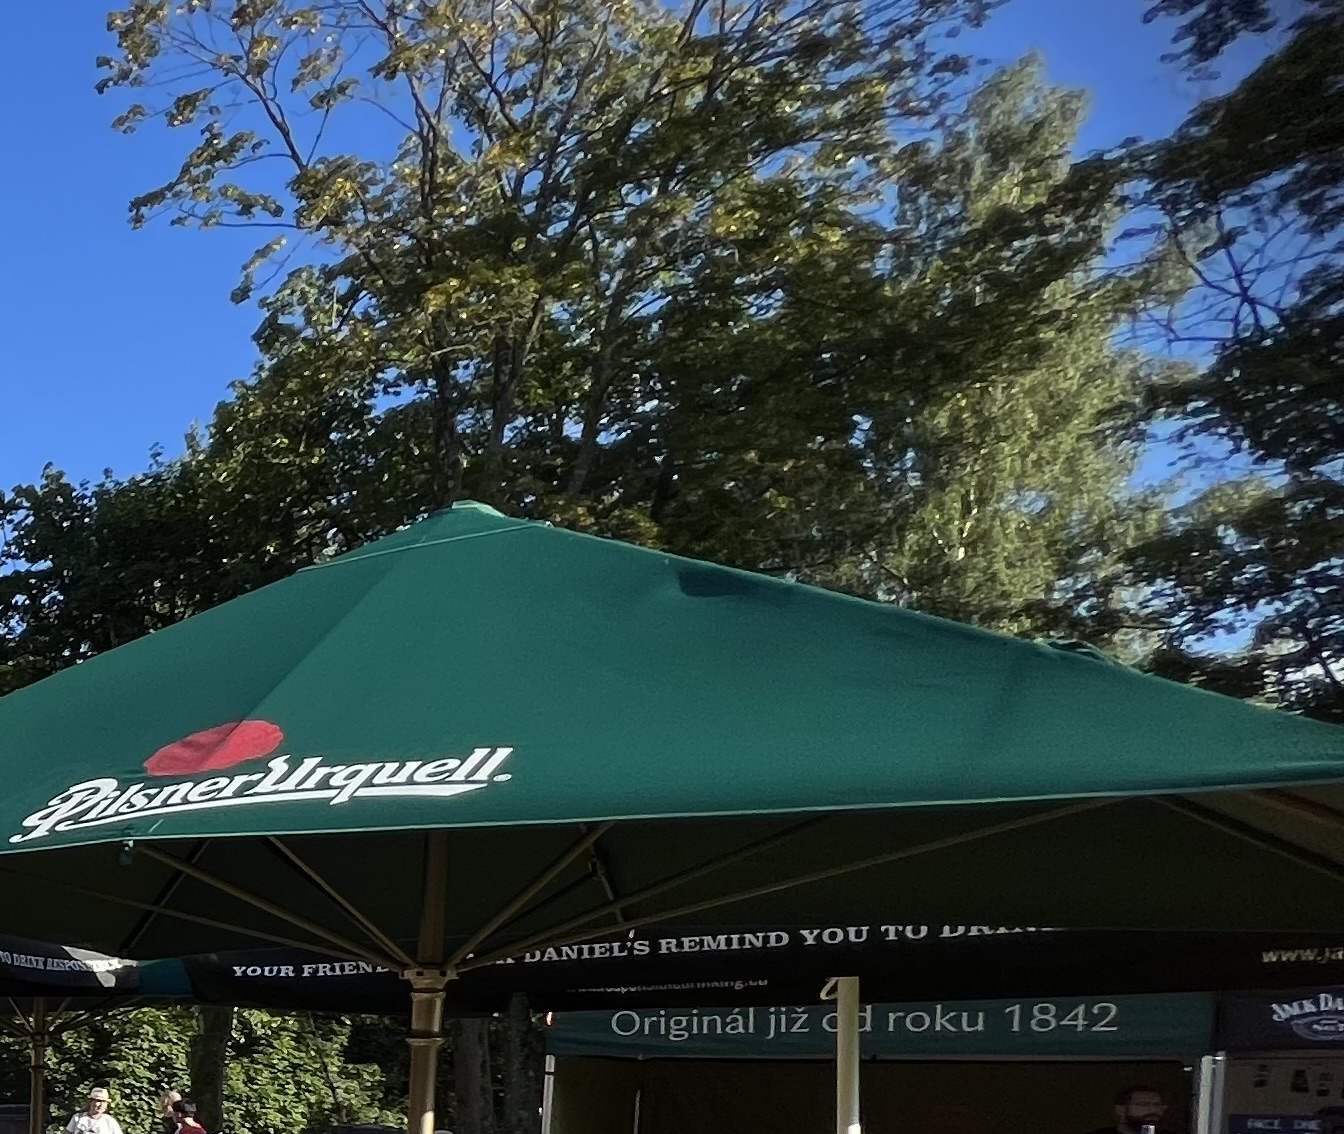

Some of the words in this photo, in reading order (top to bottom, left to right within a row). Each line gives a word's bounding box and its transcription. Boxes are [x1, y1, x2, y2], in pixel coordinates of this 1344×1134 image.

[9, 775, 258, 843] Pilsner
[232, 965, 297, 978] YOUR
[658, 931, 790, 954] REMIND
[799, 926, 870, 946] YOU
[612, 1008, 755, 1042] Originál
[766, 1006, 809, 1039] již
[888, 1004, 986, 1033] roku
[1004, 1003, 1119, 1033] 1842
